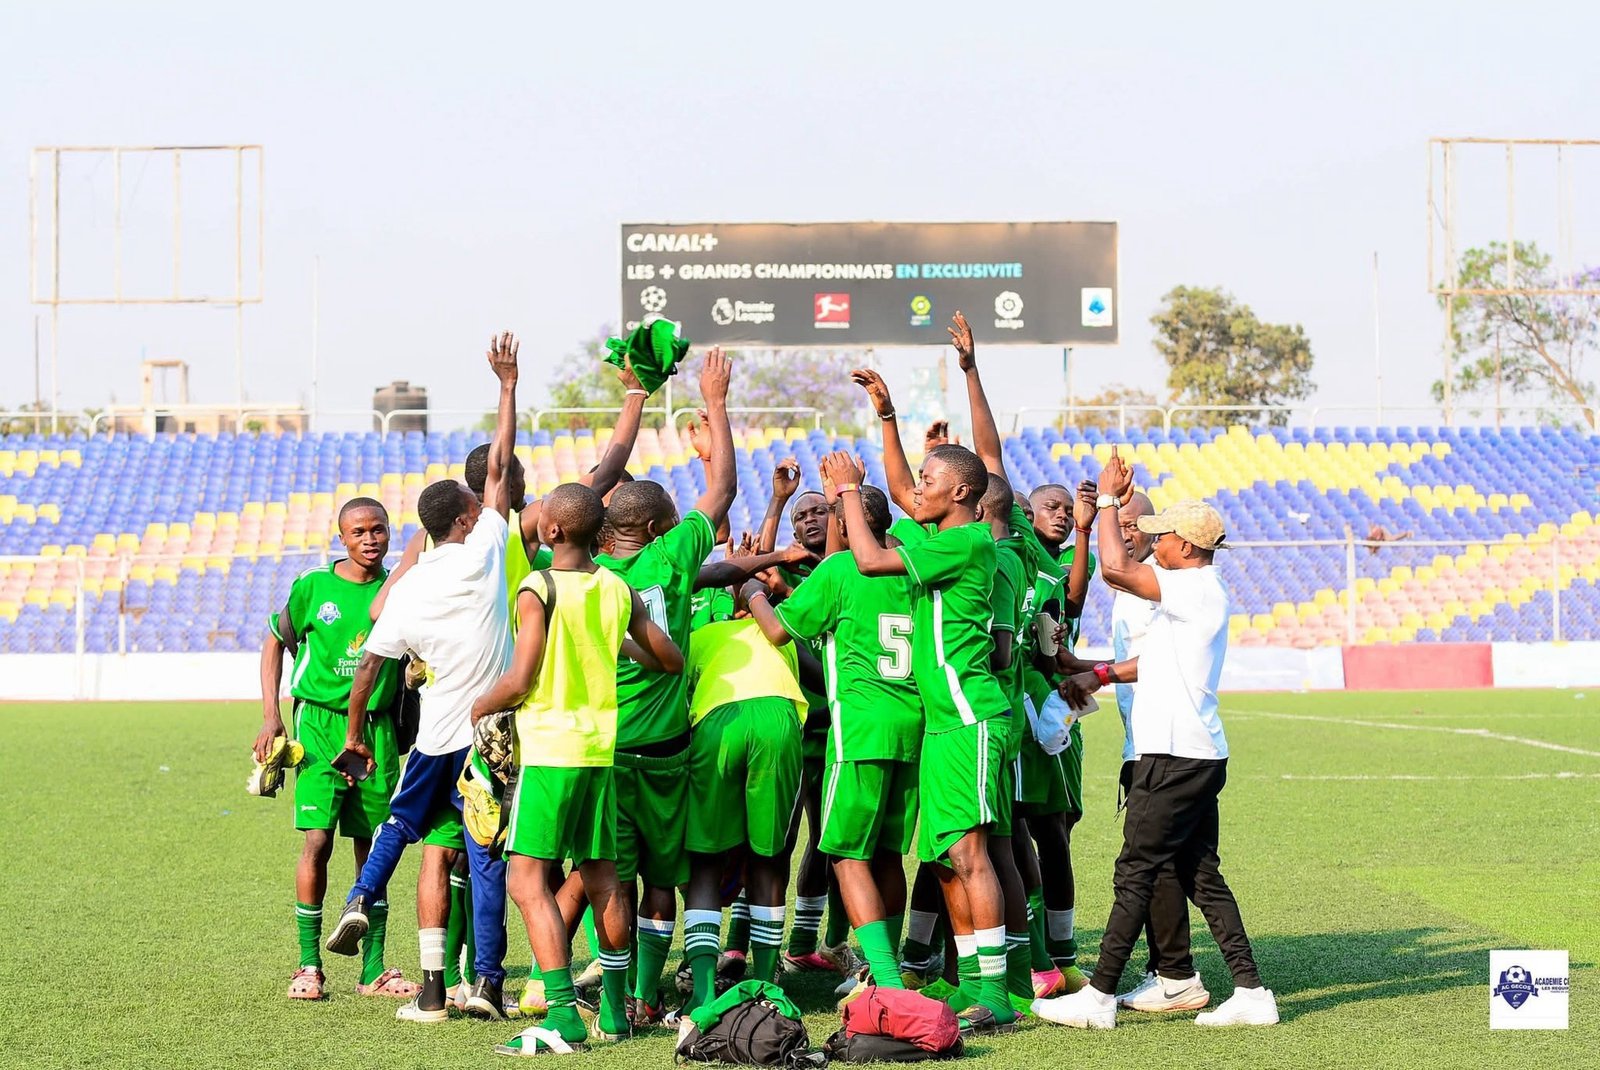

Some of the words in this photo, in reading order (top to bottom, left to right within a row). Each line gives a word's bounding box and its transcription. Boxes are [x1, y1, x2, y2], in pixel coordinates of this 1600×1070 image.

[627, 233, 718, 252] CANAL+
[627, 264, 655, 280] LES
[659, 264, 675, 280] +
[679, 264, 752, 280] GRANDS
[754, 263, 893, 280] CHAMPIONNATS
[896, 264, 919, 279] EN
[922, 262, 1023, 279] EXCLUSIVITE
[877, 613, 913, 680] 5
